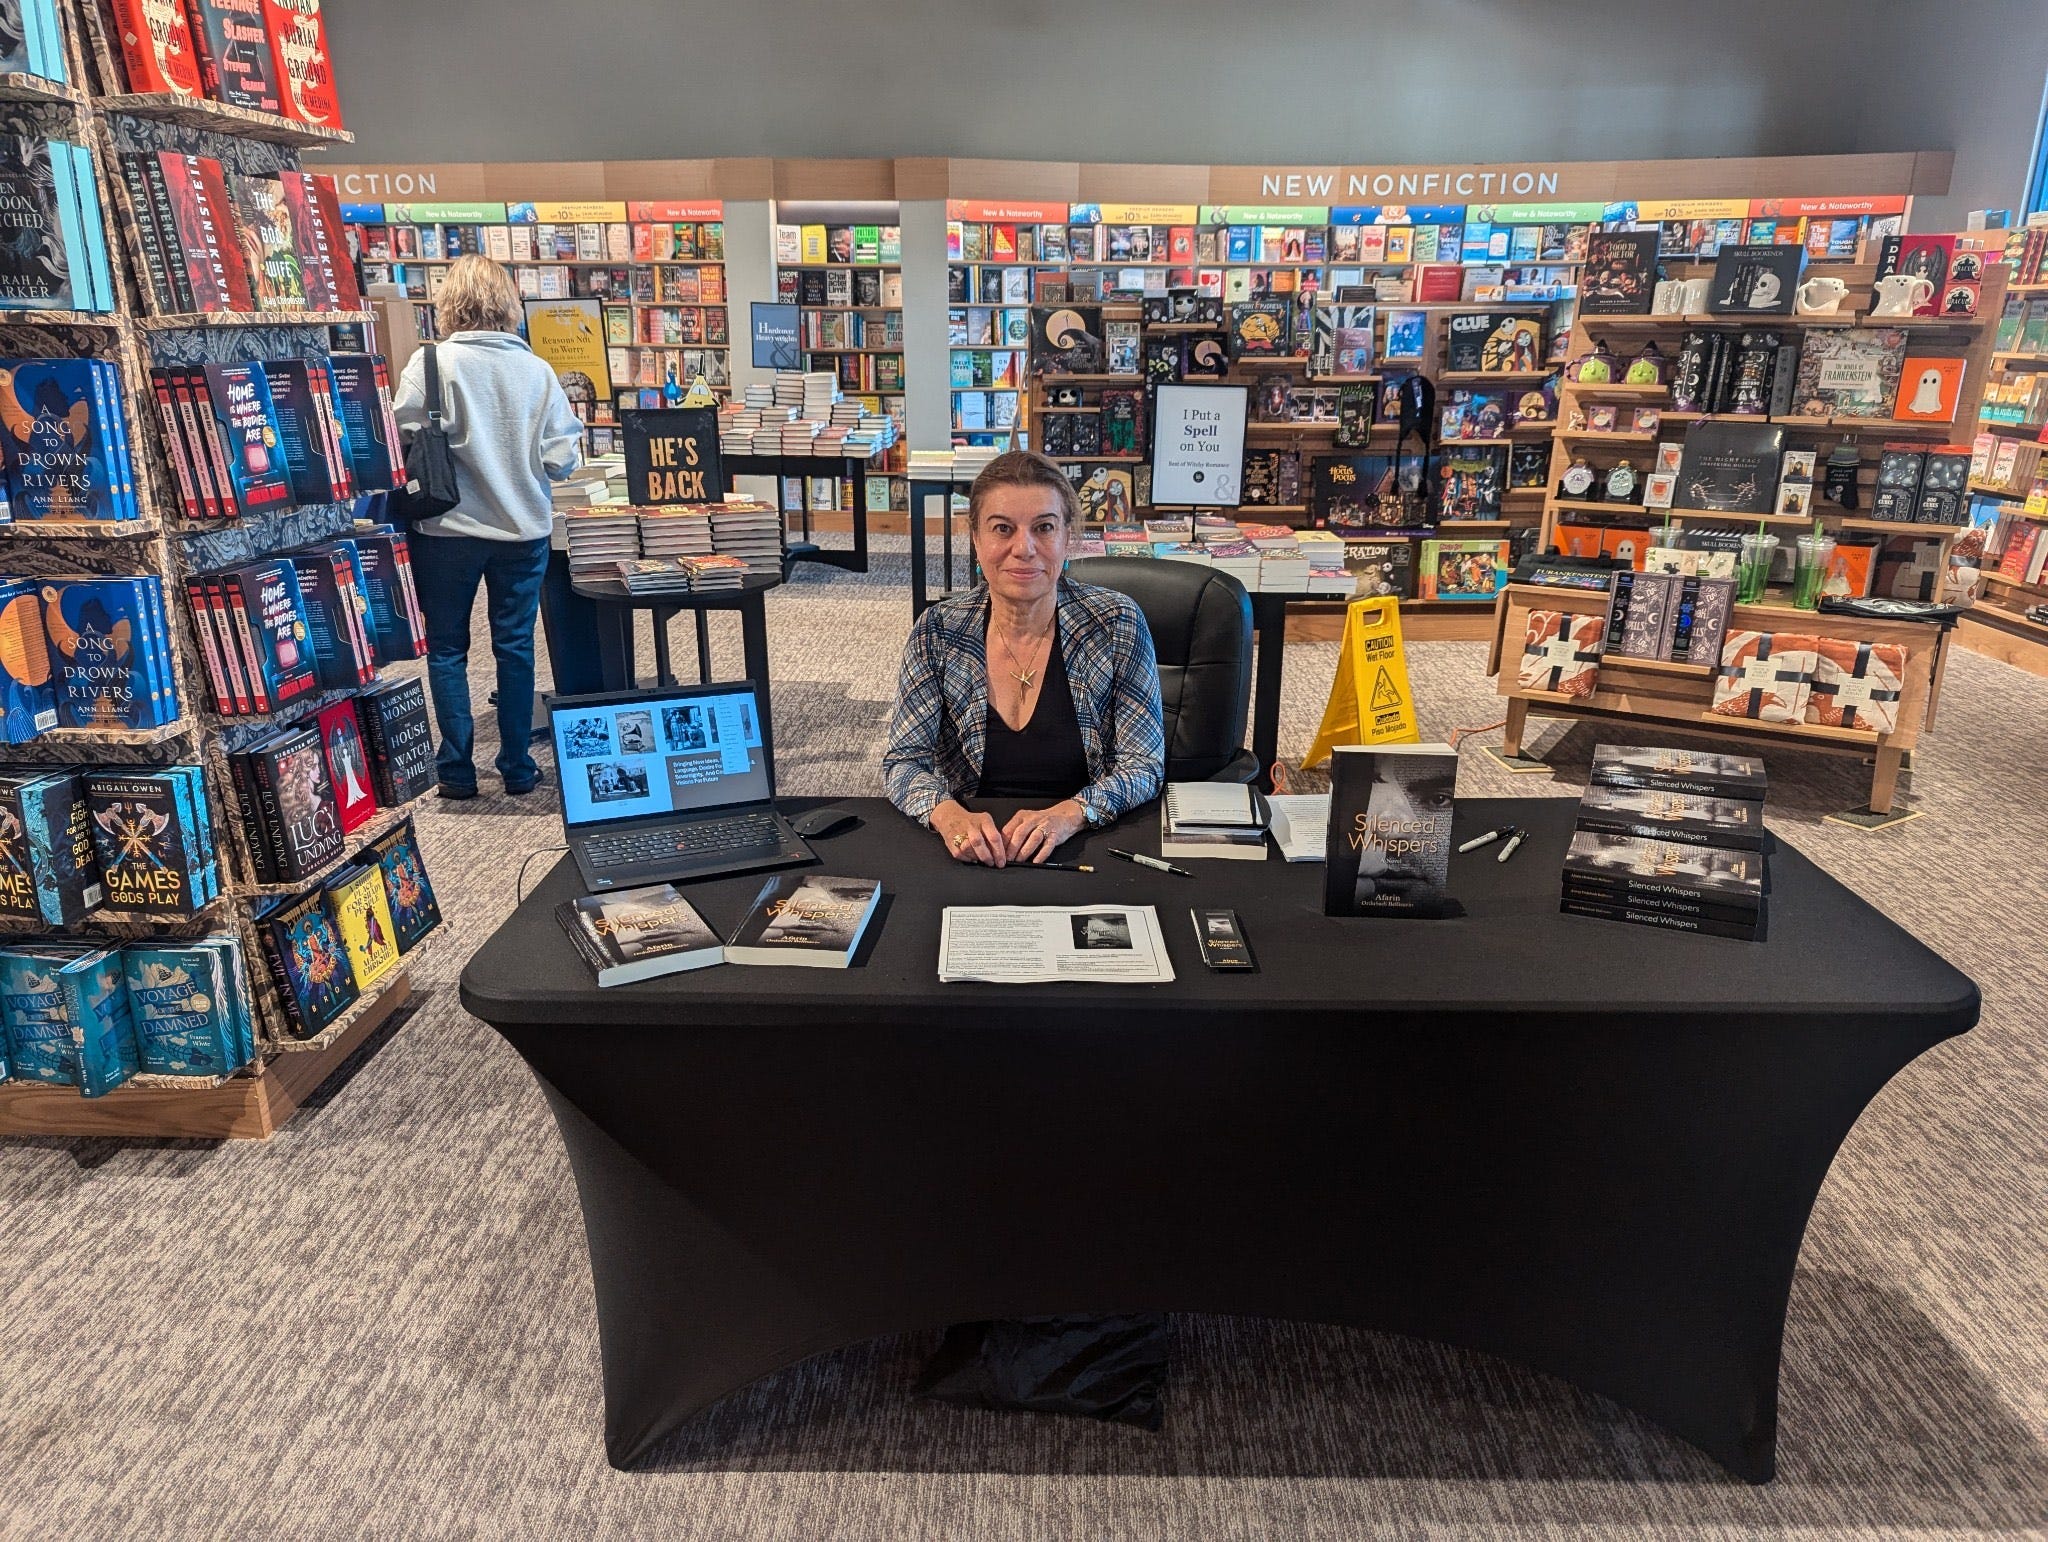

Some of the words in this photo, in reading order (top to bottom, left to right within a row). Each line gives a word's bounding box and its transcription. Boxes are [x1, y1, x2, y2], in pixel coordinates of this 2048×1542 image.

[150, 17, 188, 50] GROUND
[223, 18, 265, 44] SLASHER
[283, 23, 320, 50] BURIAL
[287, 57, 328, 85] GROUND
[334, 172, 438, 195] ICTION
[1262, 174, 1335, 196] NEW
[1348, 172, 1560, 196] NONFICTION
[425, 210, 439, 218] New
[447, 210, 482, 219] Noteworthy
[667, 208, 680, 217] New
[687, 208, 721, 218] Noteworthy
[983, 208, 997, 217] New
[1006, 209, 1043, 219] Noteworthy
[1512, 210, 1528, 218] New
[1537, 209, 1577, 218] Noteworthy
[1801, 203, 1818, 211] New
[1828, 202, 1873, 211] Noteworthy
[1243, 212, 1258, 220] New
[1266, 212, 1303, 221] Noteworthy
[186, 154, 232, 312] FRANKENSTEIN
[303, 173, 341, 313] FRANKENSTEIN
[265, 261, 293, 278] WIFE
[758, 322, 795, 335] Hardcover
[1452, 315, 1490, 332] CLUE
[542, 336, 574, 345] Reasons
[577, 335, 592, 344] Not
[756, 333, 798, 344] Heavyweights
[560, 346, 585, 356] Worry
[1824, 370, 1873, 382] FRANKENSTEIN
[227, 383, 255, 402] HOME
[41, 403, 51, 415] A
[236, 401, 261, 416] WHERE
[1192, 409, 1211, 420] Put
[1214, 411, 1221, 420] a
[22, 420, 72, 436] SONG
[231, 417, 242, 427] THE
[242, 414, 267, 428] BODIES
[245, 427, 262, 443] ARE
[1184, 425, 1217, 438] Spell
[43, 438, 58, 447] TO
[1180, 442, 1194, 452] on
[1198, 441, 1220, 452] You
[650, 437, 698, 467] HE'S
[18, 452, 88, 469] DROWN
[1329, 466, 1354, 476] HOCUS
[23, 474, 91, 491] RIVERS
[648, 471, 707, 500] BACK
[33, 495, 54, 503] ANN
[58, 495, 87, 503] LIANG
[1344, 545, 1390, 559] ERATION
[261, 582, 286, 603] HOME
[268, 599, 291, 616] WHERE
[274, 611, 297, 627] BODIES
[85, 622, 95, 633] A
[277, 625, 291, 640] ARE
[67, 637, 114, 652] SONG
[1365, 636, 1394, 651] CAUTION
[87, 653, 102, 662] TO
[1366, 653, 1378, 663] Wet
[1379, 650, 1395, 661] Floor
[64, 666, 129, 683] DROWN
[68, 686, 133, 701] RIVERS
[101, 705, 130, 713] LIANG
[383, 695, 424, 721] MONING
[391, 720, 427, 748] HOUSE
[1372, 727, 1384, 737] Piso
[1385, 722, 1407, 734] Mojado
[394, 740, 430, 767] WATCH
[406, 760, 426, 779] HILL
[90, 784, 129, 793] ABIGAIL
[132, 784, 162, 793] OWEN
[1650, 778, 1680, 788] Silenced
[1681, 782, 1715, 793] Whispers
[262, 791, 275, 816] LUCY
[290, 802, 335, 850] LUCY
[1354, 814, 1436, 834] Silenced
[1671, 830, 1708, 841] Whispers
[268, 820, 288, 868] UNDYING
[296, 830, 342, 867] UNDYING
[1348, 832, 1439, 857] Whispers
[75, 850, 93, 869] DEAT
[132, 862, 147, 871] THE
[105, 869, 181, 893] GAMES
[1628, 880, 1661, 892] Silenced
[1662, 885, 1701, 898] Whispers
[111, 891, 144, 904] GODS
[150, 892, 180, 906] PLAY
[346, 898, 362, 914] FOR
[774, 899, 853, 911] Silenced
[1627, 895, 1660, 907] Silenced
[1661, 900, 1700, 913] Whispers
[595, 905, 679, 928] Silenced
[766, 907, 853, 920] Whispers
[1626, 911, 1658, 923] Silenced
[1660, 916, 1698, 929] Whispers
[595, 914, 688, 936] Whispers
[8, 991, 64, 1009] VOYAGE
[136, 981, 199, 1003] VOYAGE
[286, 1001, 300, 1018] ME
[142, 1014, 209, 1034] DAMNED
